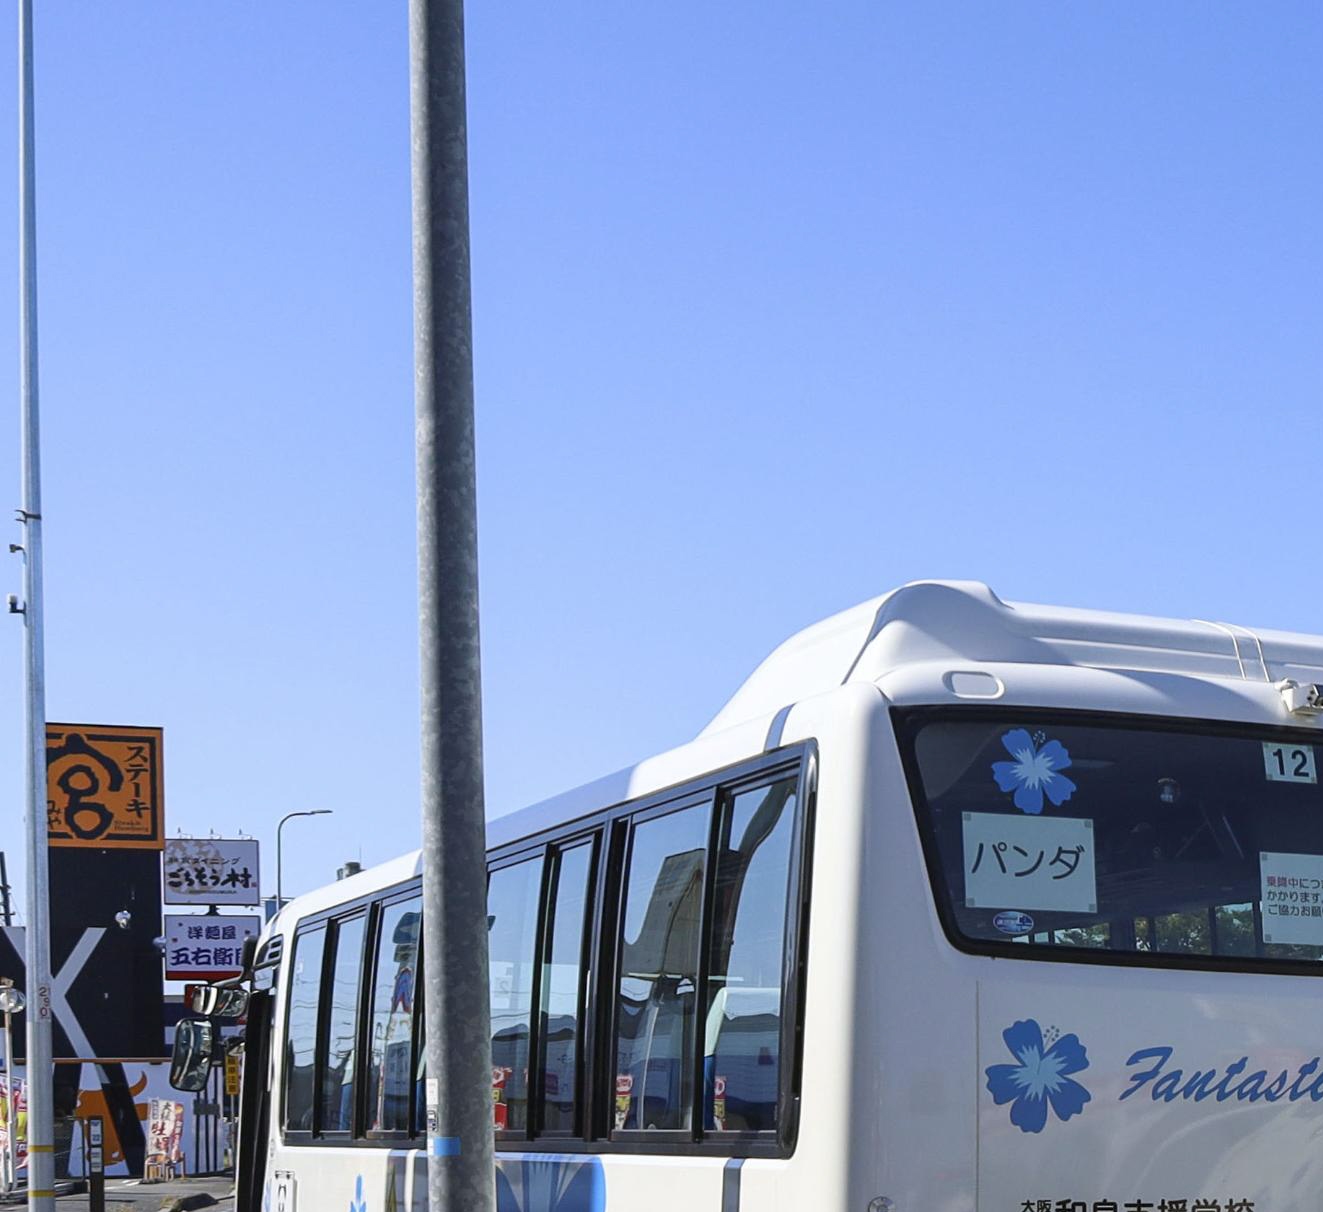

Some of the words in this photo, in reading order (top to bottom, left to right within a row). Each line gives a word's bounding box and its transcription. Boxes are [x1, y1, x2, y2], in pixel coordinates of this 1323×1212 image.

[1271, 750, 1311, 778] 12
[125, 745, 149, 818] ステーキ
[168, 867, 252, 888] ごちそう村
[971, 842, 1085, 880] パンダ
